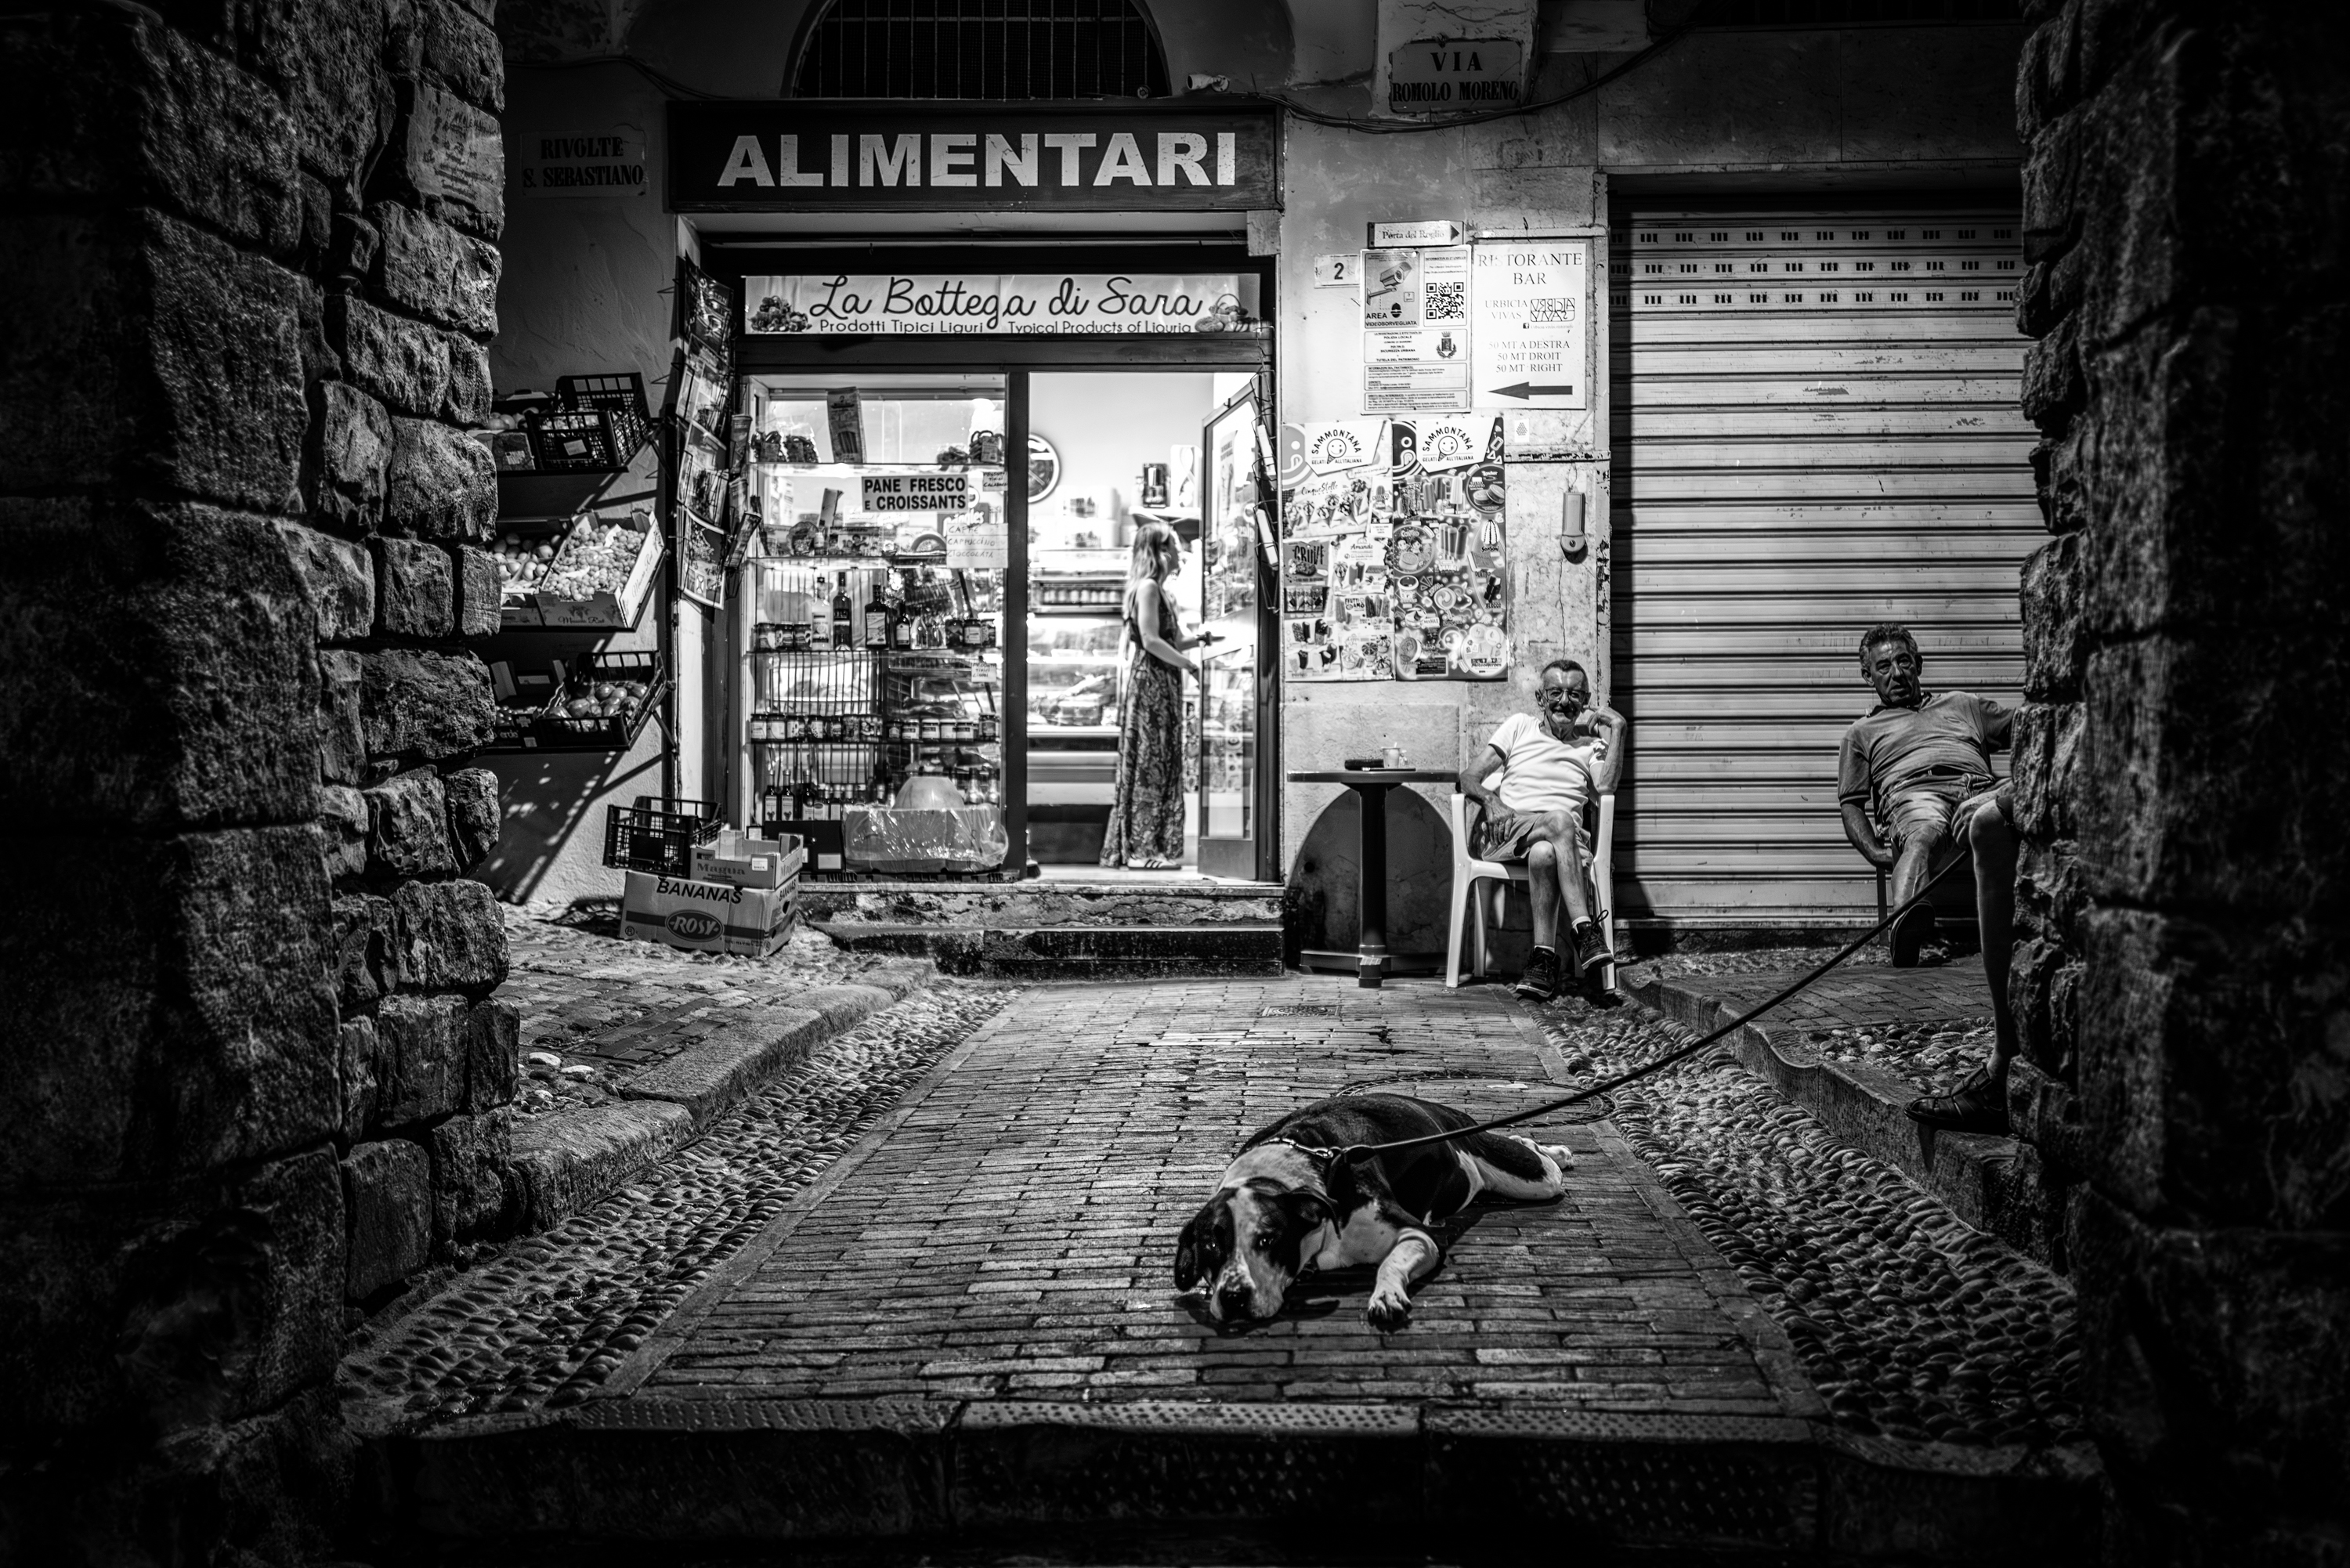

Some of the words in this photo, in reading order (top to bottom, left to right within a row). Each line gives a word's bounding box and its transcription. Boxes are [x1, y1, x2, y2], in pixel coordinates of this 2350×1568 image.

[1430, 52, 1483, 71] VIA
[1392, 81, 1451, 102] ROMOLO
[1459, 81, 1519, 100] MORENO
[540, 136, 624, 159] RIVOLTE
[716, 132, 1235, 187] ALIMENTARI
[522, 168, 537, 188] S.
[543, 164, 644, 187] SEBASTIANO
[1477, 253, 1582, 266] RISTORANTE
[1334, 262, 1344, 280] 2
[1513, 273, 1547, 284] BAR
[809, 276, 872, 320] La
[883, 276, 1036, 330] Bottega
[1049, 277, 1090, 315] di
[1097, 276, 1203, 316] Sara
[820, 320, 885, 333] Prodotti
[891, 320, 934, 334] Tipici
[940, 320, 983, 334] Liguri
[1007, 321, 1058, 334] Typical
[1062, 320, 1123, 334] Products
[1127, 320, 1142, 333] of
[1529, 340, 1570, 349] DESTRA
[1529, 352, 1562, 360] DROIT
[1531, 363, 1563, 372] RIGHT
[1311, 429, 1361, 454] SAMMONTANA
[1422, 426, 1473, 452] SAMMONTANA
[864, 478, 901, 493] PANE
[909, 477, 966, 493] FRESCO
[865, 500, 870, 511] E
[877, 495, 966, 511] CROISSANTS
[656, 880, 743, 904] BANANAS
[672, 916, 716, 936] ROSY
